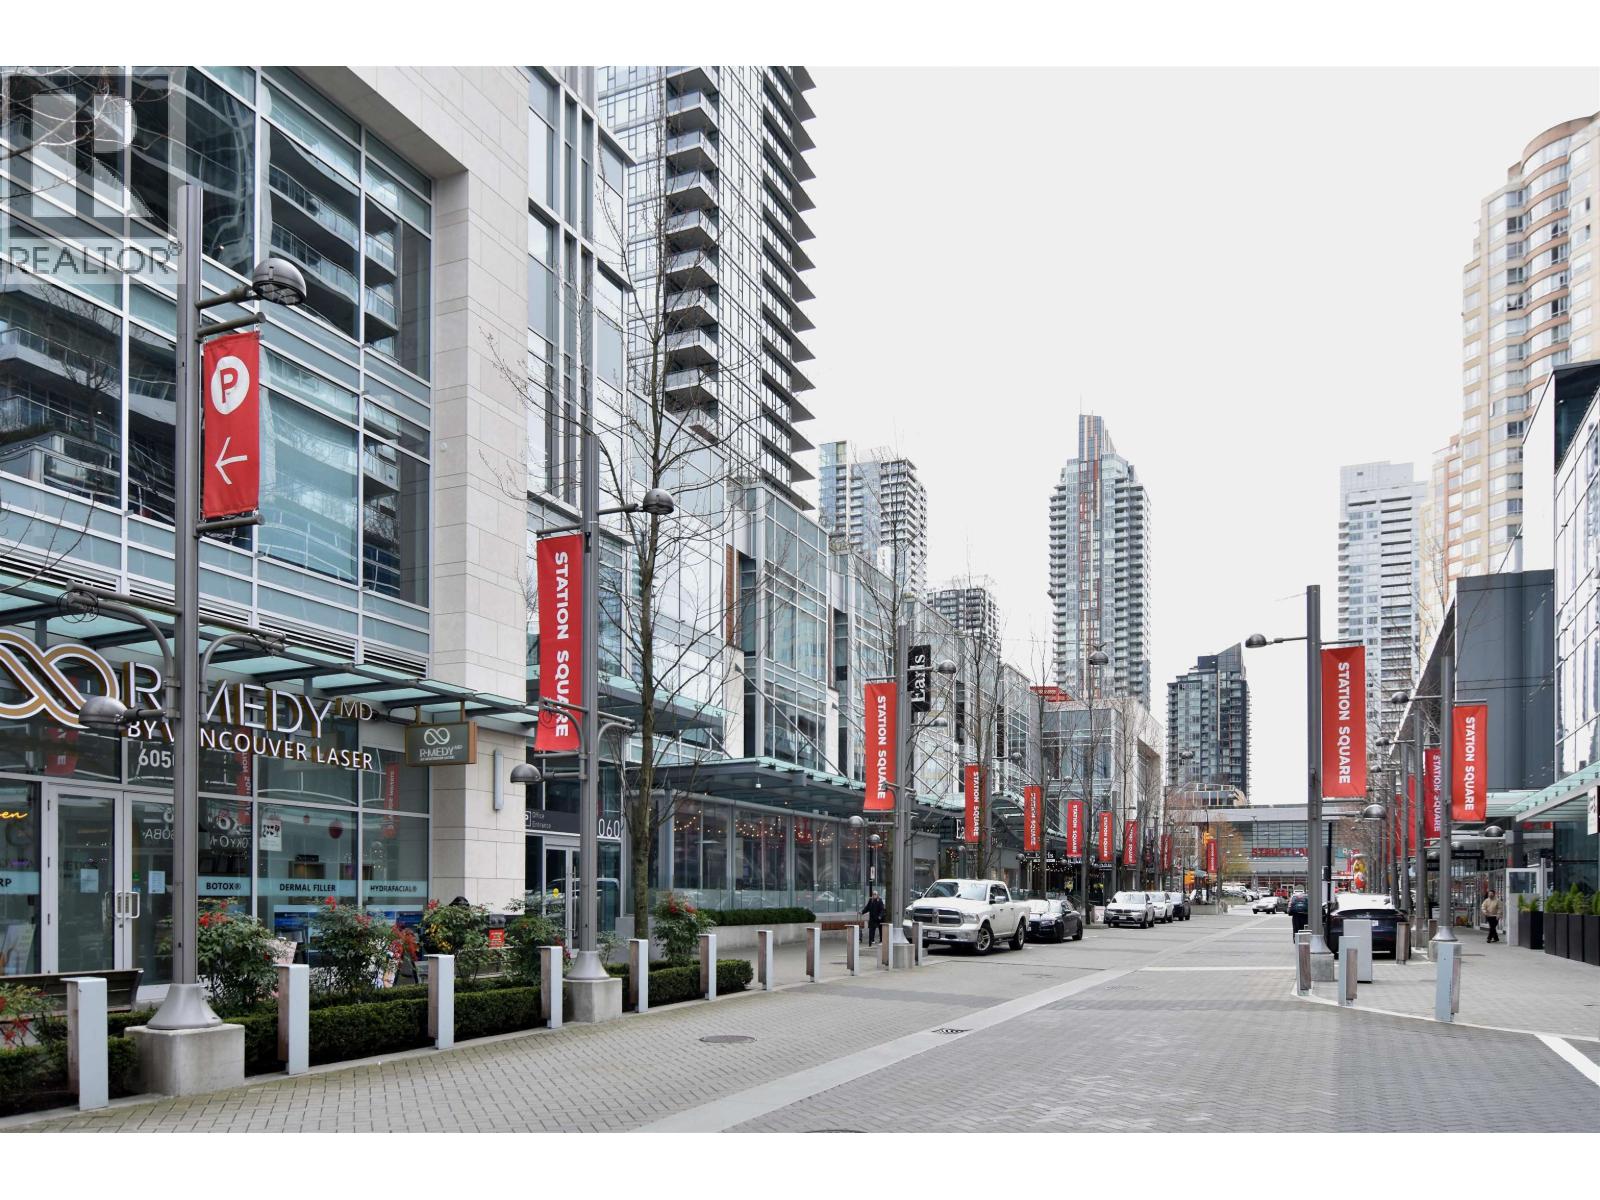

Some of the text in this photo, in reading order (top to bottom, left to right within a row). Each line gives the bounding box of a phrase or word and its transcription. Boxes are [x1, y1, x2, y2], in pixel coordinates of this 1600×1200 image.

[219, 366, 239, 404] P
[554, 551, 569, 640] STATION
[910, 654, 926, 702] Earls
[337, 700, 373, 721] MD
[877, 695, 887, 746] STATION
[1336, 661, 1351, 784] STATION SQUARE
[138, 749, 175, 768] 605
[315, 746, 373, 771] LASER
[1433, 754, 1441, 791] STATION
[1463, 716, 1476, 811] STATION SQUARE
[206, 882, 242, 891] BOTOX®
[279, 883, 336, 892] DERMAL FILLER
